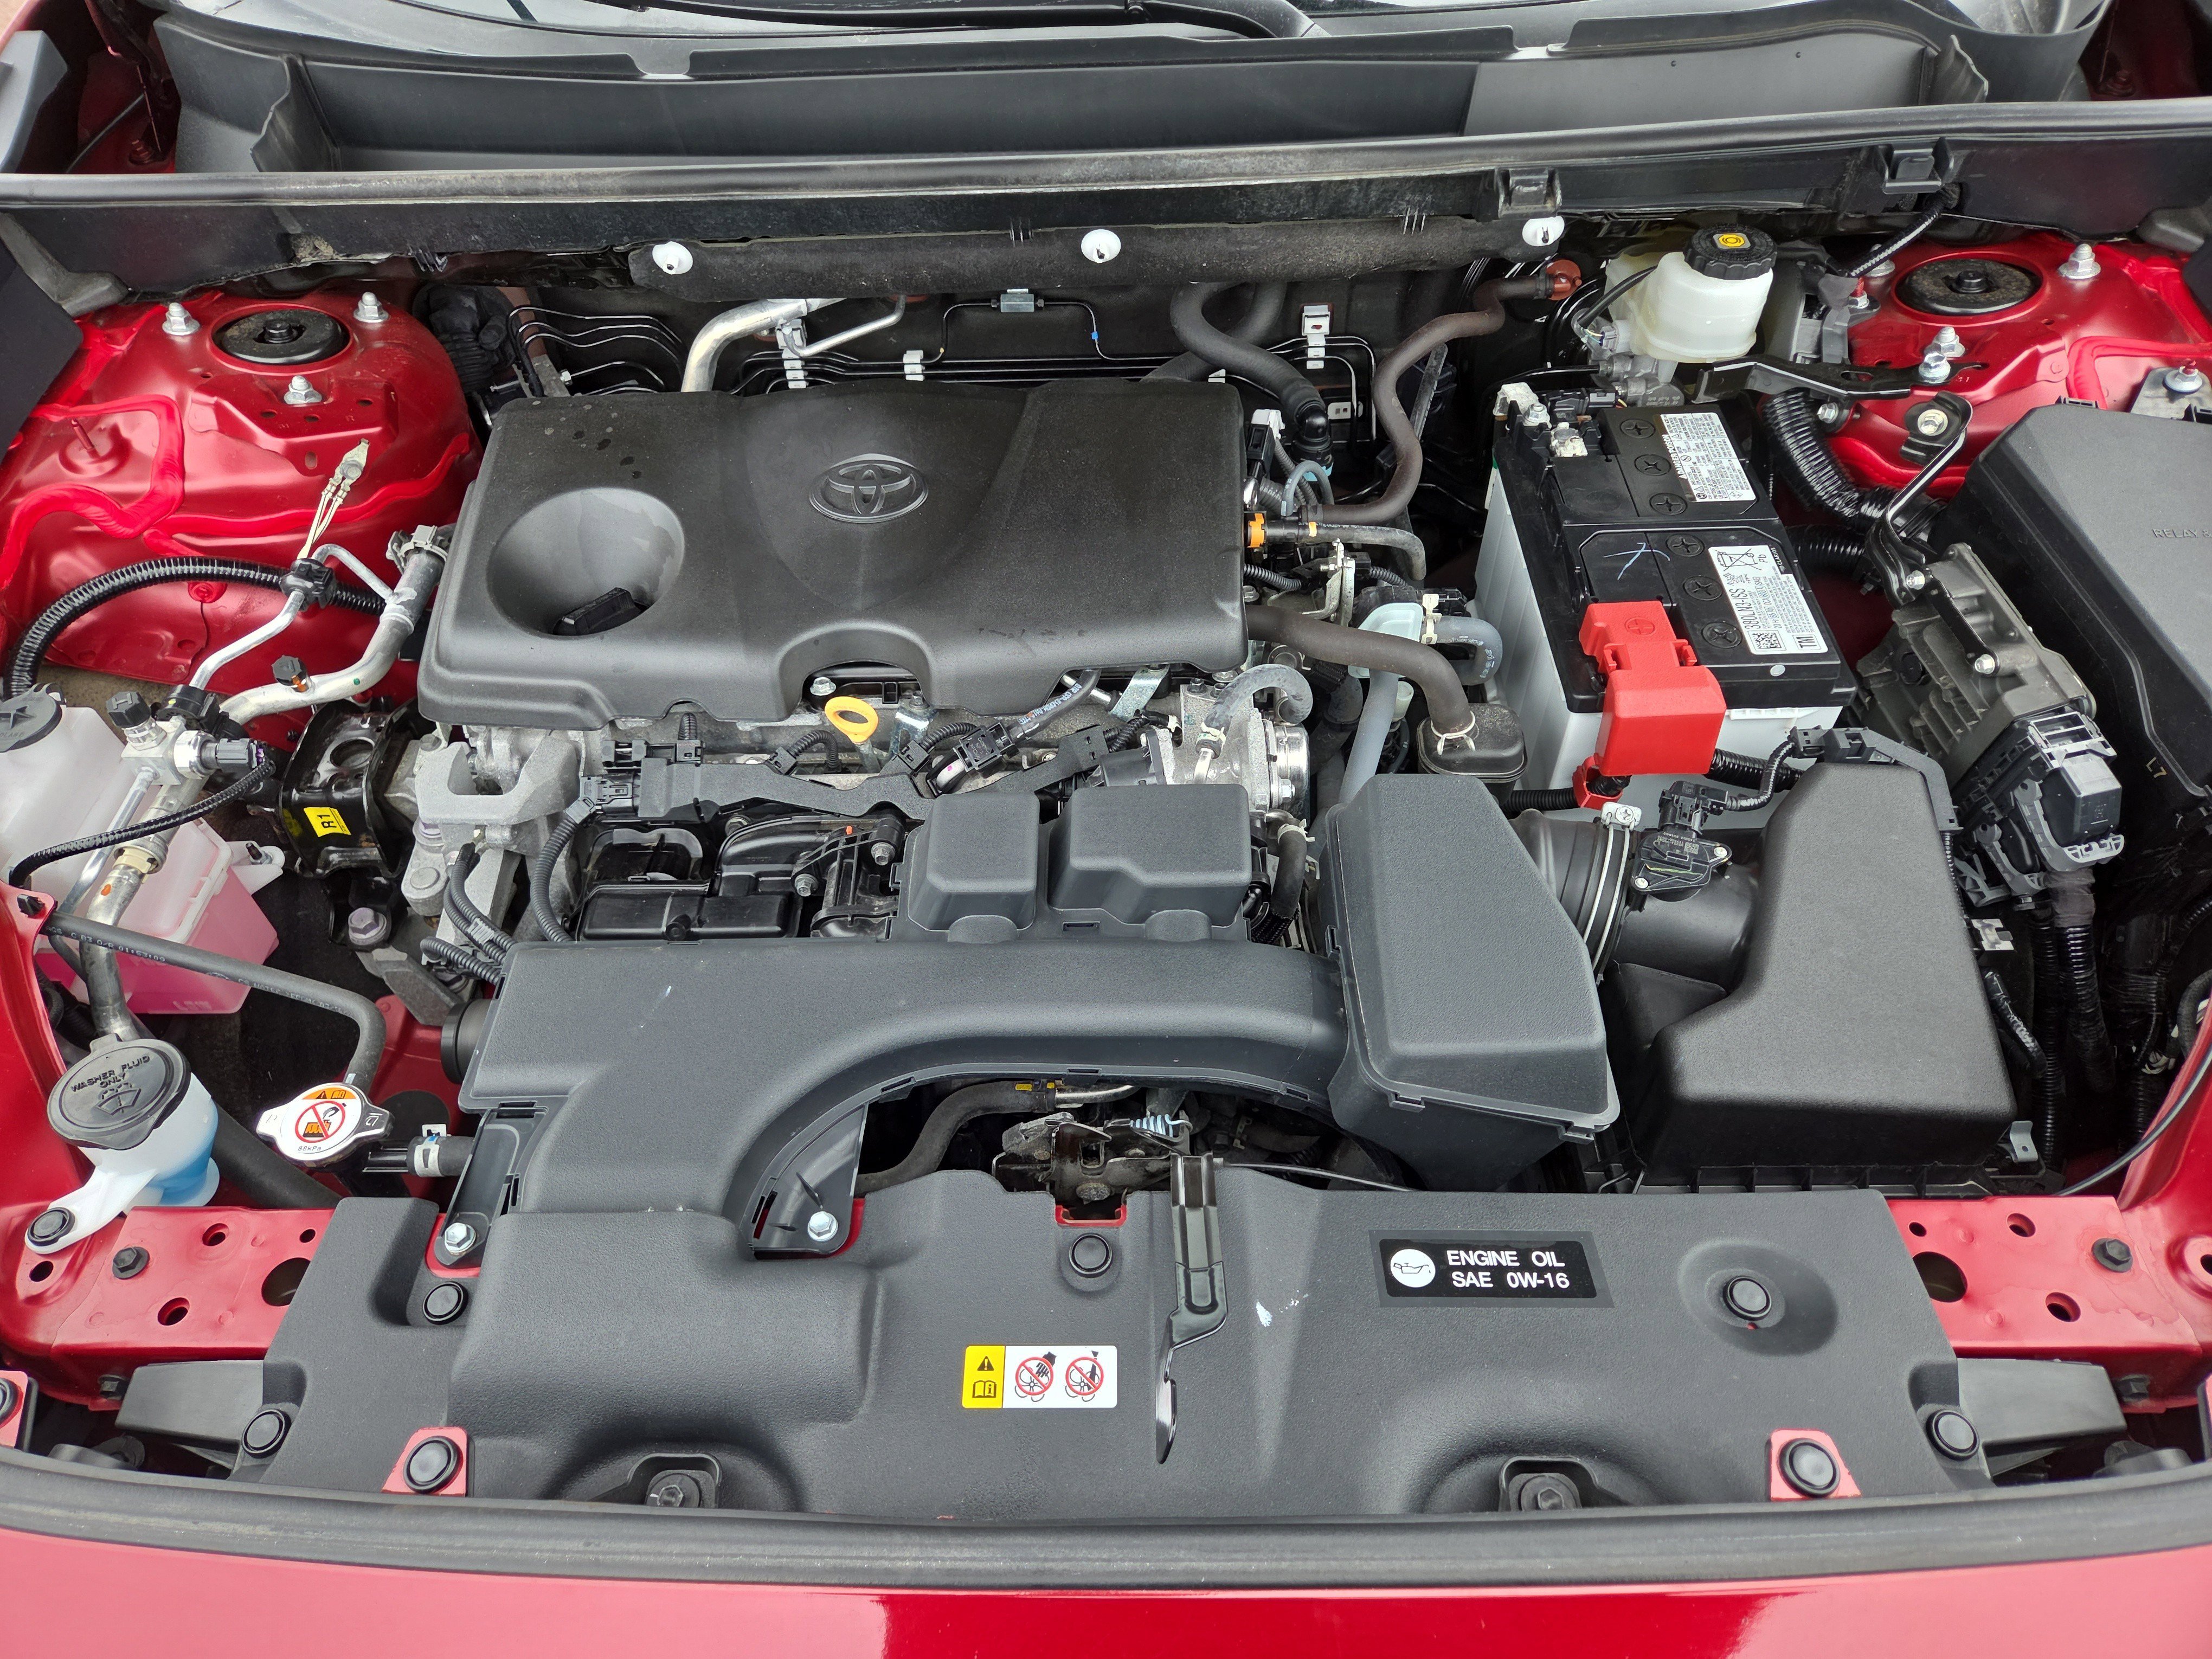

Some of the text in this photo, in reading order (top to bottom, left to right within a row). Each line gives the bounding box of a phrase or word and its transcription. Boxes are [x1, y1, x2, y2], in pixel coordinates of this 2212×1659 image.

[2152, 529, 2200, 538] RELAY
[1758, 554, 1769, 563] Pb
[1728, 588, 1761, 629] 380LN3-ISS
[1796, 636, 1817, 648] TM
[2145, 756, 2168, 779] L7
[317, 814, 337, 829] R1
[70, 1055, 151, 1092] WASHER FLUID
[99, 1072, 127, 1088] ONLY
[1446, 1250, 1566, 1268] ENGINE OIL
[1451, 1271, 1570, 1289] SAE 0W-16
